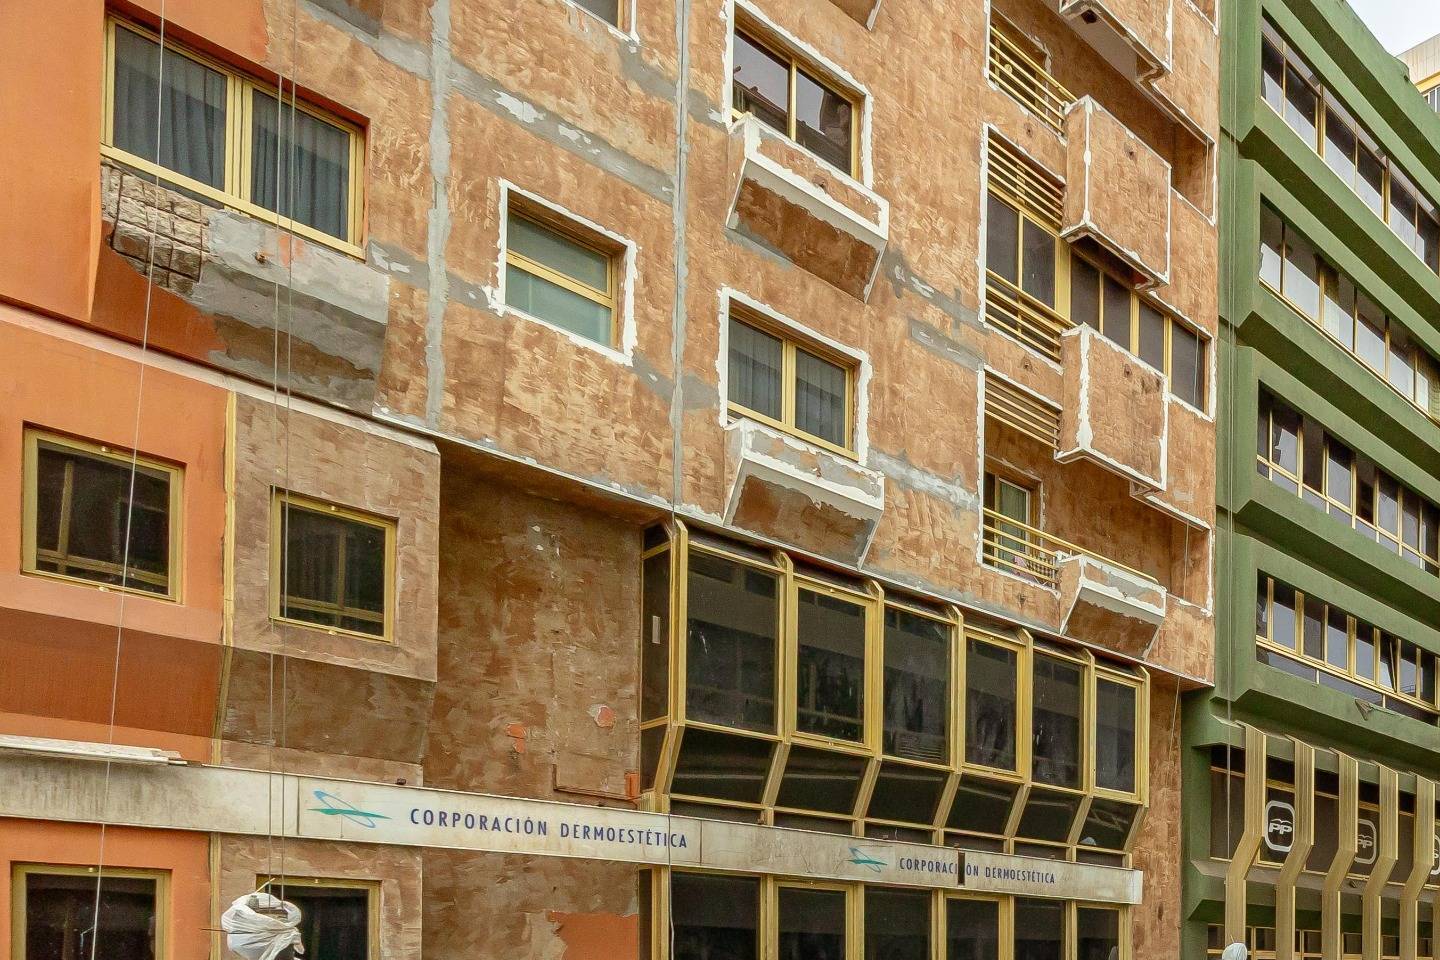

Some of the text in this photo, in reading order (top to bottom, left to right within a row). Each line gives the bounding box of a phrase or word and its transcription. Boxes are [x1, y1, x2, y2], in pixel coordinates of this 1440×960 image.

[410, 808, 688, 849] CORPORACIÓN DERMOESTÉTICA
[899, 857, 1055, 884] CORPORACIÓN DERMOESTÉTICA
